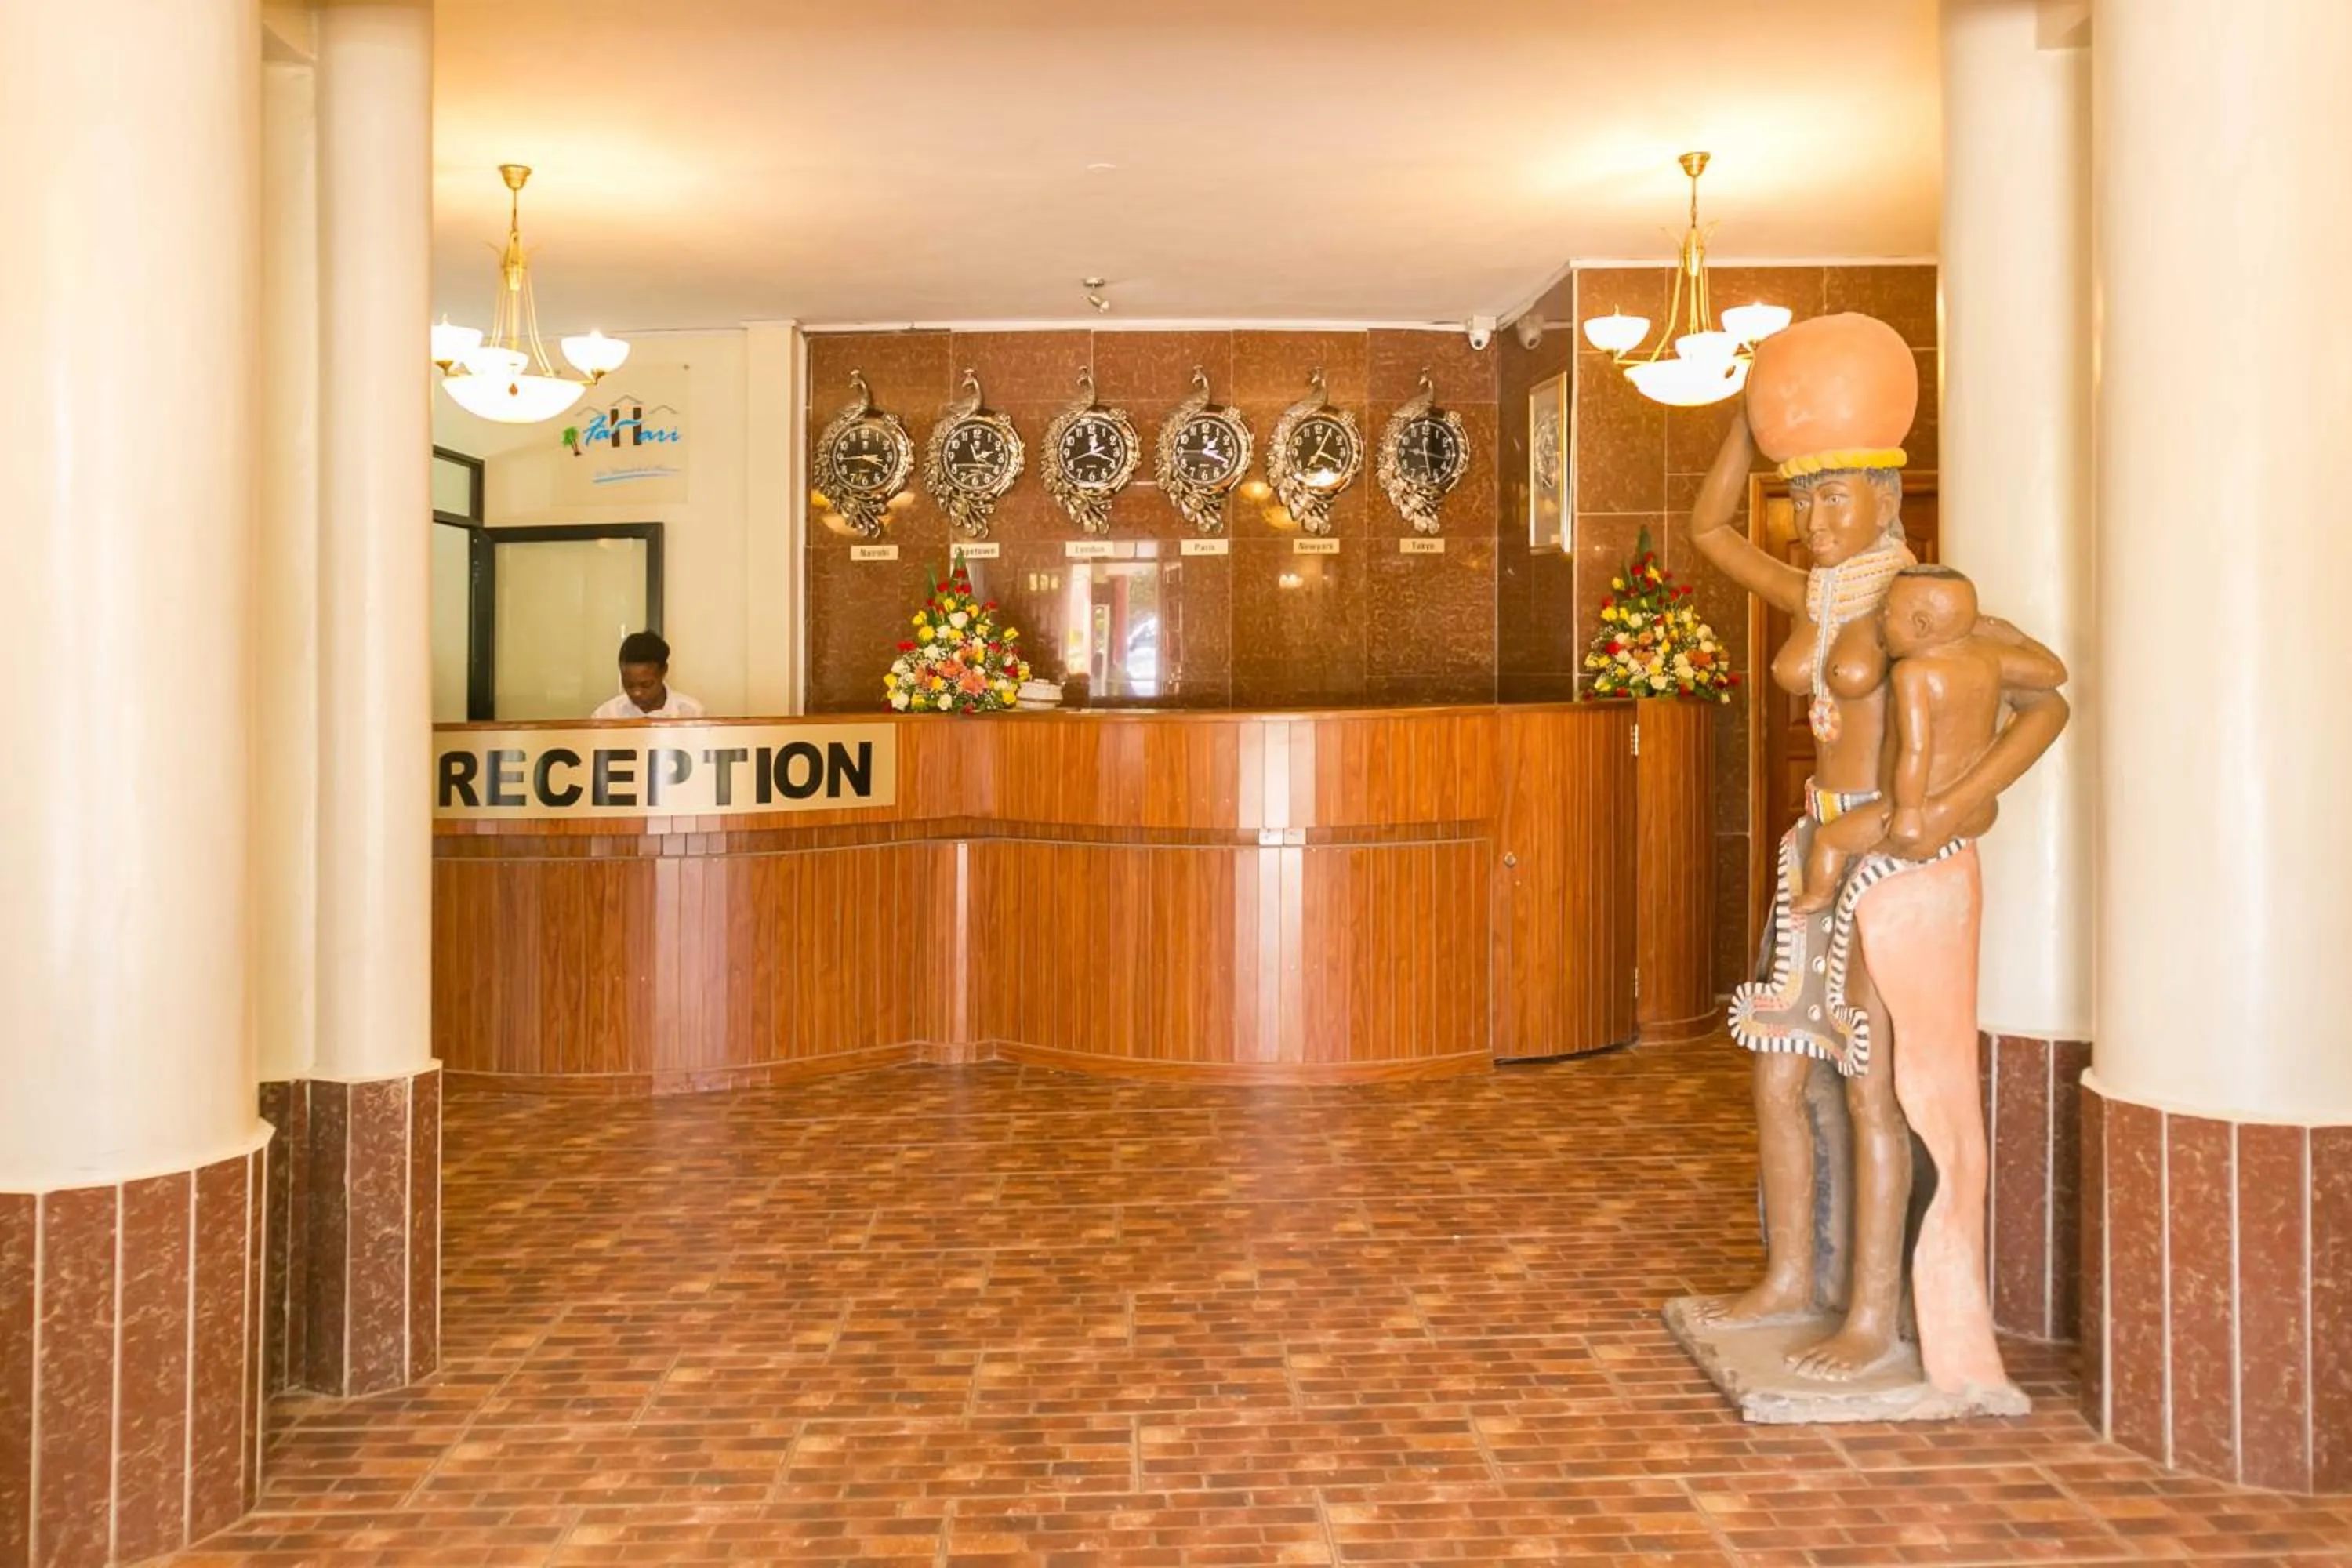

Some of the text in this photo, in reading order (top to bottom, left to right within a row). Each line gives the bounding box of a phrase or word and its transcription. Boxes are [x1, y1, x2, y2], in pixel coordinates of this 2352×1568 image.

[1076, 428, 1082, 437] 11
[1088, 425, 1095, 434] 12
[1202, 423, 1209, 433] 12
[1304, 428, 1309, 437] 11
[1315, 425, 1323, 434] 12
[850, 432, 856, 442] 11
[861, 430, 869, 439] 12
[962, 431, 967, 441] 11
[973, 429, 982, 438] 12
[952, 439, 960, 449] 10
[1067, 436, 1075, 446] 10
[1109, 435, 1116, 445] 2
[1181, 434, 1189, 444] 10
[1223, 436, 1229, 445] 2
[1294, 436, 1302, 445] 10
[1336, 436, 1342, 445] 2
[1402, 437, 1410, 445] 10
[1443, 438, 1447, 447] 2
[840, 441, 848, 451] 10
[883, 440, 890, 451] 2
[995, 441, 1001, 451] 2
[1063, 448, 1069, 458] 9
[1113, 447, 1120, 458] 3
[1178, 447, 1184, 456] 9
[1226, 448, 1232, 458] 3
[1292, 448, 1298, 458] 9
[1340, 448, 1345, 458] 3
[1399, 448, 1405, 457] 9
[1445, 449, 1450, 459] 3
[837, 453, 844, 463] 9
[887, 452, 892, 462] 3
[948, 452, 955, 462] 9
[997, 452, 1004, 463] 3
[1067, 459, 1073, 470] 8
[1109, 459, 1115, 469] 4
[1181, 458, 1187, 469] 8
[1402, 459, 1408, 469] 8
[1440, 461, 1446, 470] 4
[841, 465, 848, 475] 8
[883, 464, 887, 474] 4
[952, 464, 957, 474] 8
[1076, 469, 1082, 478] 7
[1101, 469, 1107, 479] 5
[1189, 467, 1196, 477] 7
[850, 473, 856, 483] 7
[1089, 471, 1095, 481] 6
[1201, 470, 1207, 480] 6
[862, 477, 868, 485] 6
[972, 477, 978, 485] 6
[438, 741, 873, 808] RECEPTION
